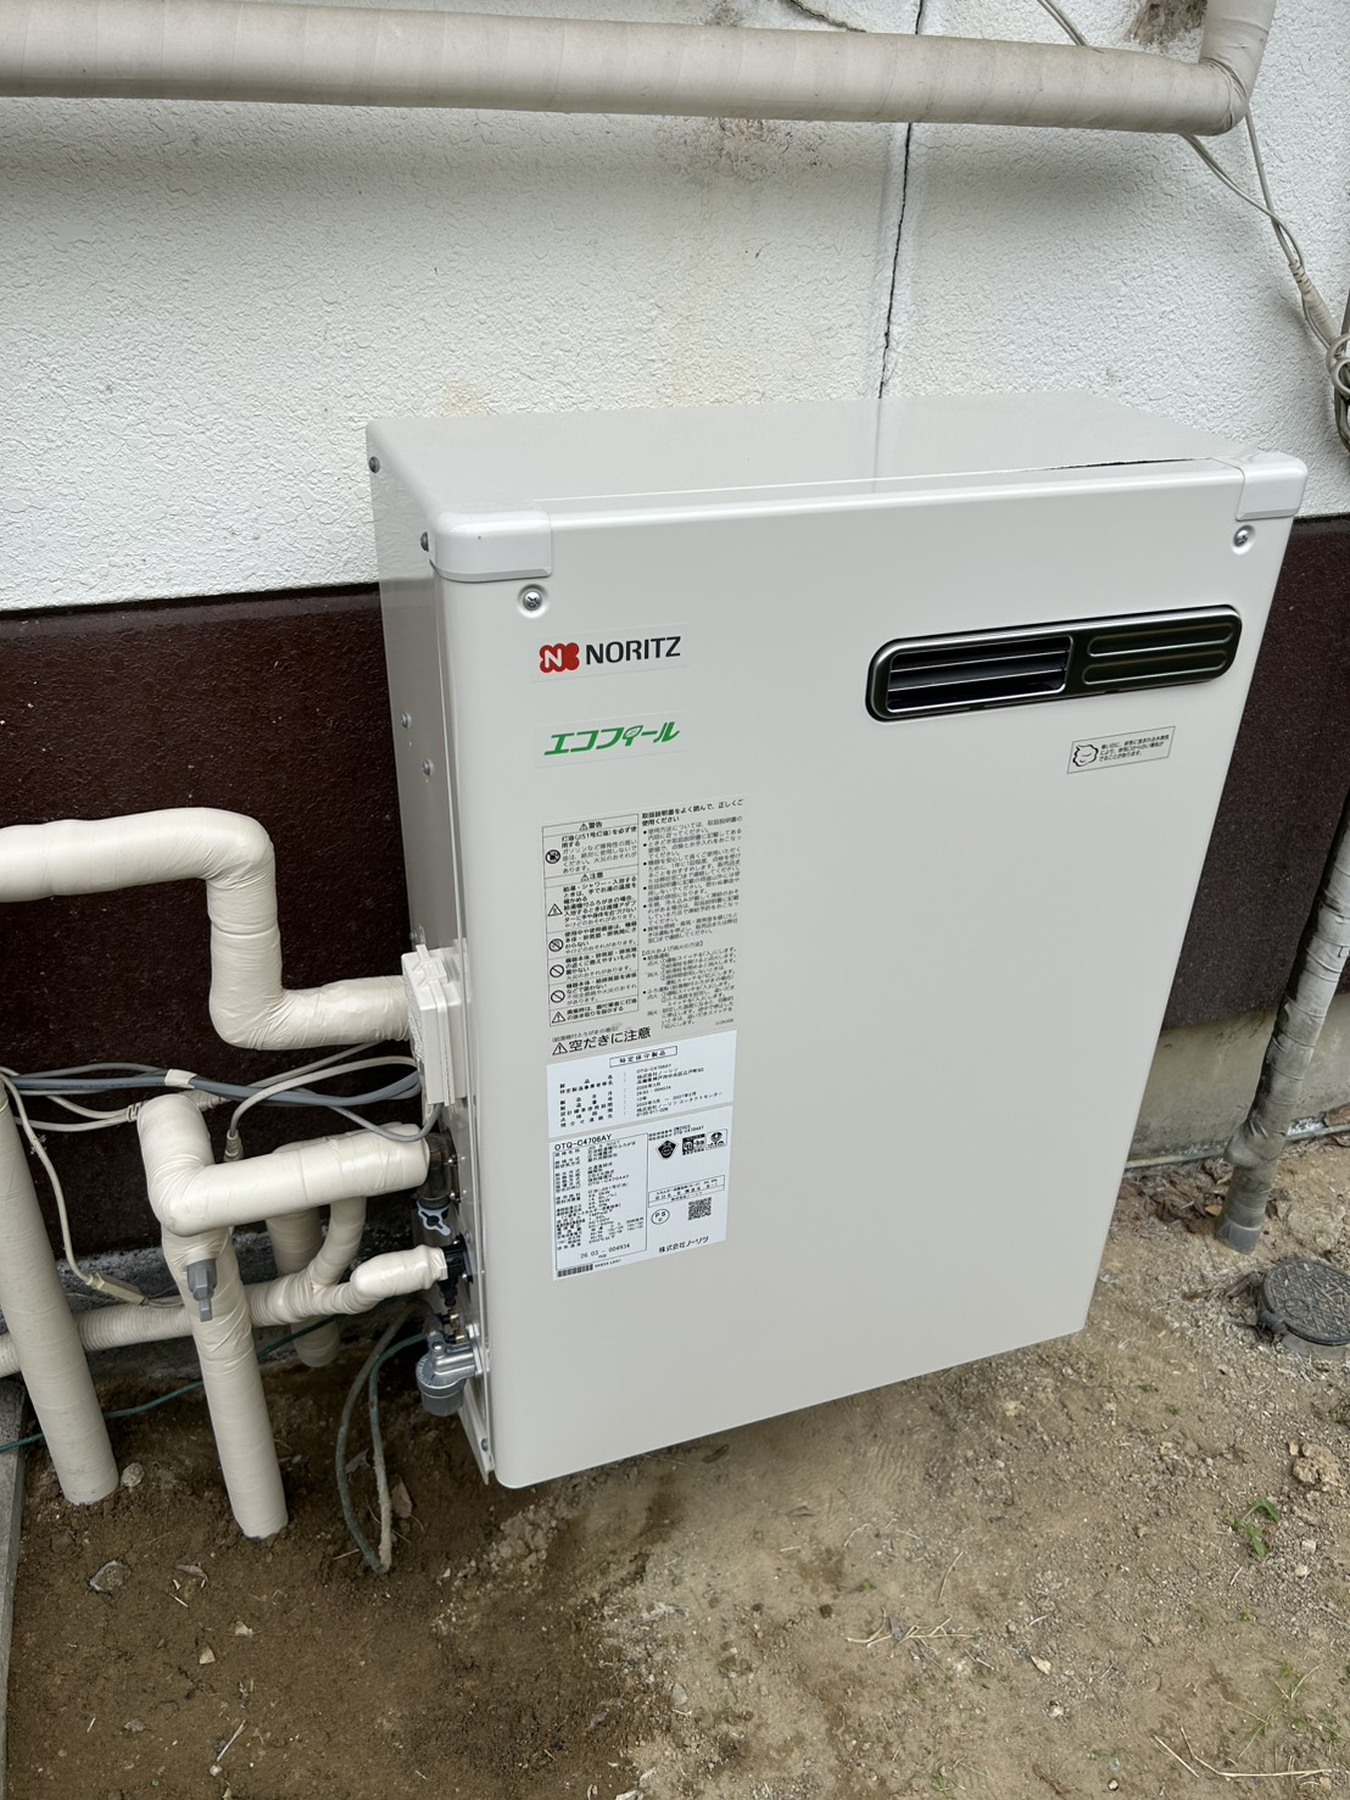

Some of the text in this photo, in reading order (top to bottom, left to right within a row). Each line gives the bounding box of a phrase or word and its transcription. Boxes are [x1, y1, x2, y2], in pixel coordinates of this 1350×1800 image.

[585, 636, 681, 665] NORITZ
[544, 721, 680, 756] エコフィール
[568, 1026, 652, 1053] 空だきに注意
[554, 1133, 612, 1151] OTQ-C4706AY
